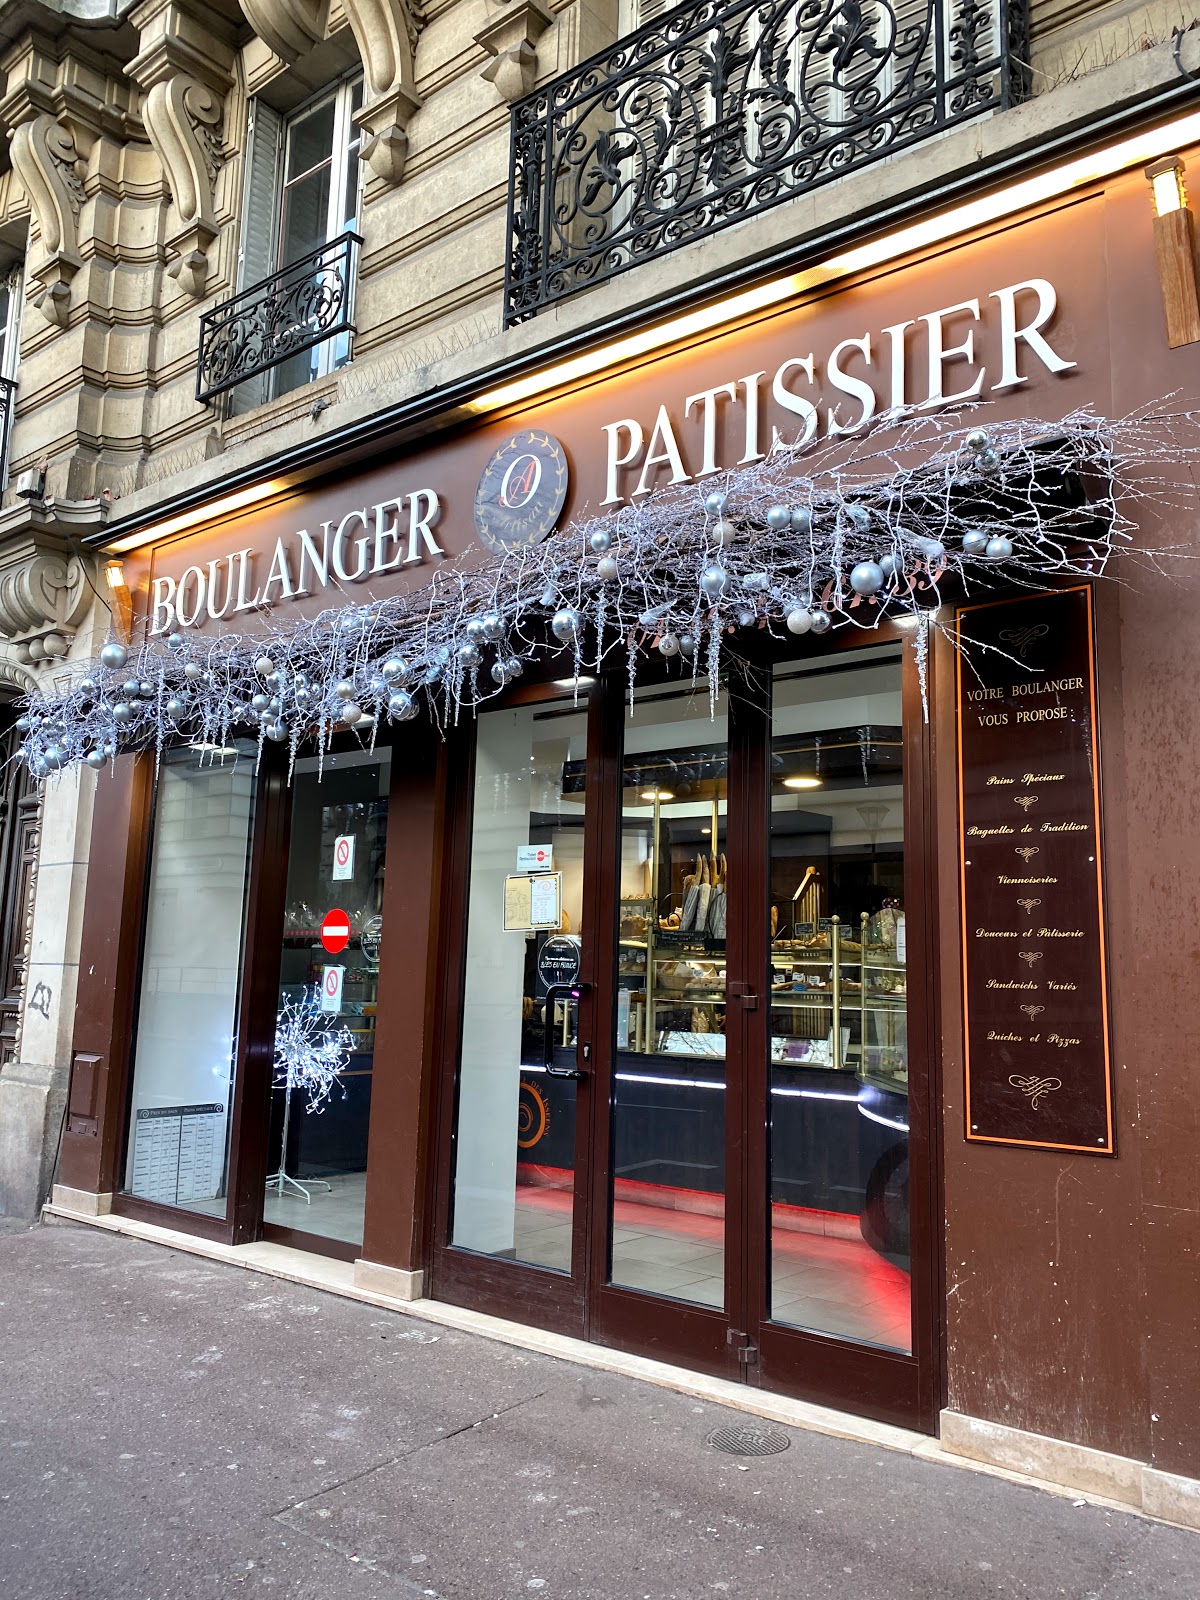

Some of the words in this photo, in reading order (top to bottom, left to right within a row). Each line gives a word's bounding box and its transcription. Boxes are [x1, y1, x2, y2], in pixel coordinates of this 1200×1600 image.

[599, 278, 1077, 507] PATISSIER
[148, 488, 445, 637] BOULANGER
[967, 687, 1004, 702] VOTRE
[1012, 677, 1084, 697] BOULANGER
[978, 713, 1009, 727] VOUS
[986, 775, 1015, 786] Pains
[1020, 772, 1065, 786] Spéciaux
[967, 826, 1015, 839] Baguettes
[1020, 824, 1034, 833] de
[1040, 822, 1089, 833] Tradition
[997, 875, 1058, 885] Viennoiseries
[975, 928, 1019, 938] Douceurs
[1022, 929, 1033, 938] et
[986, 979, 1039, 990] Sandwichs
[1047, 980, 1079, 991] Variés
[987, 1030, 1023, 1042] Quiches
[1029, 1033, 1041, 1043] et
[1047, 1033, 1082, 1048] Pizzas
